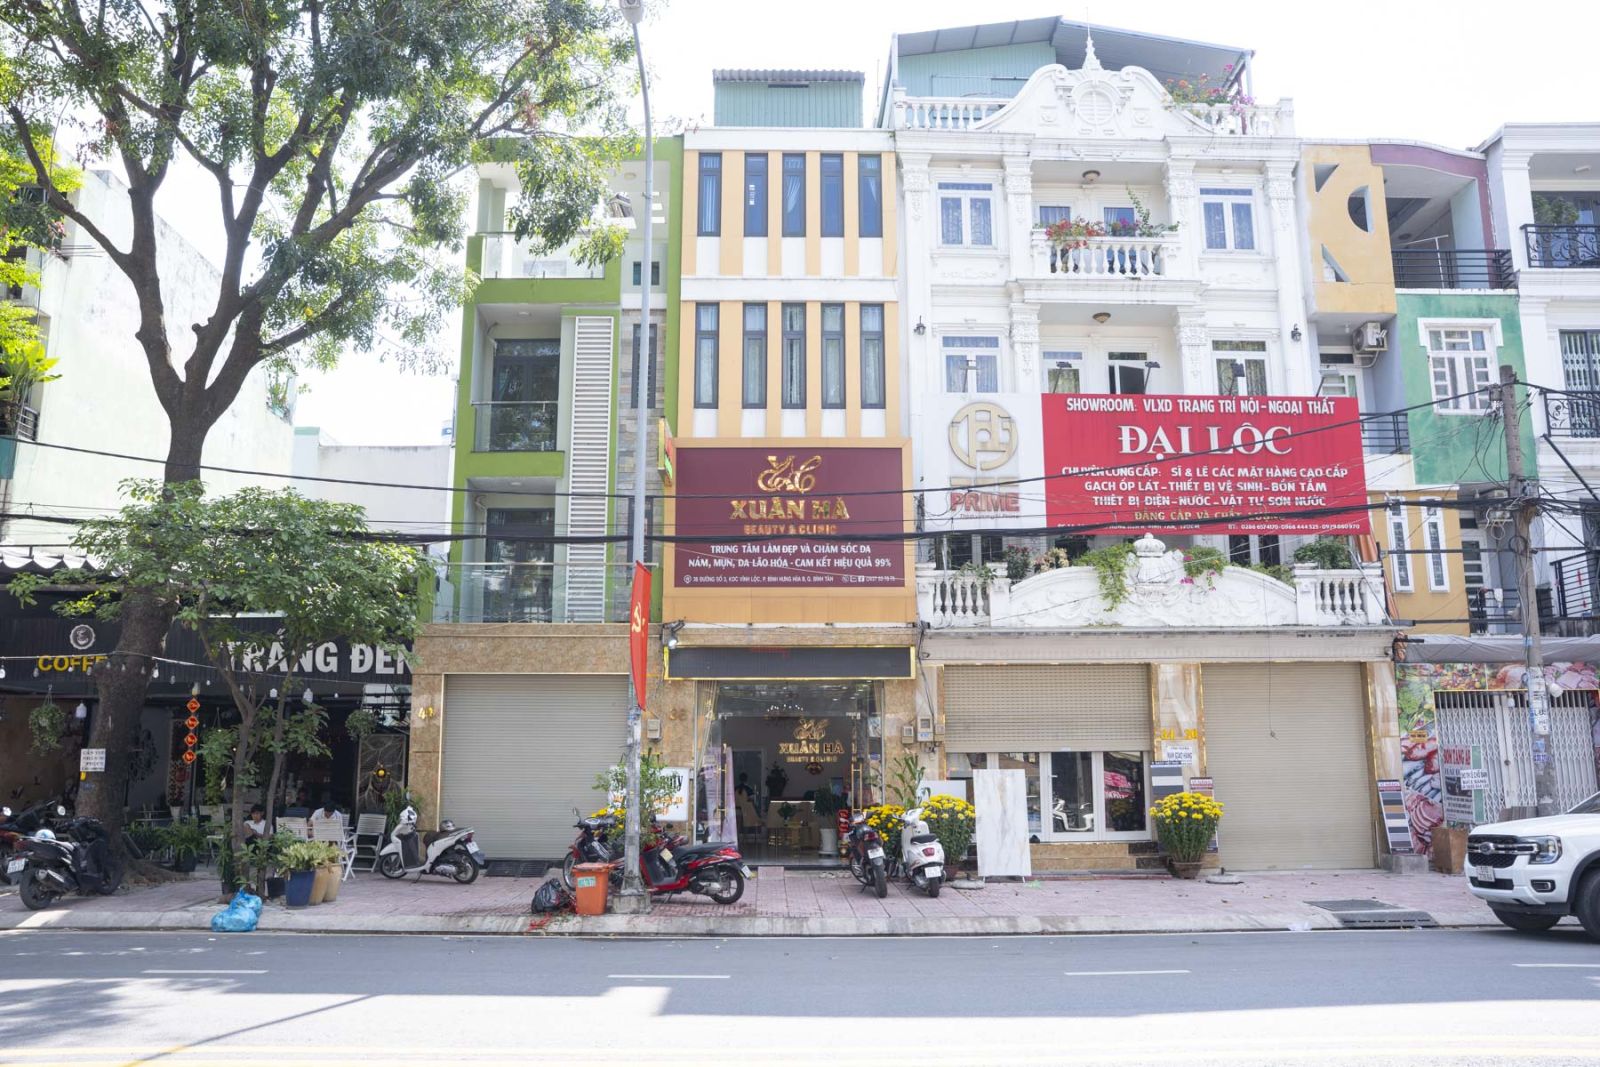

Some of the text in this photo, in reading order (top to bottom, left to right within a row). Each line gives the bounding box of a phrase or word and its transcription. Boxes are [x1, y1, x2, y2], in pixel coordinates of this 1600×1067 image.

[1066, 398, 1138, 412] SHOWROOM:
[1143, 399, 1173, 413] VLXD
[1177, 399, 1215, 413] TRANG
[1219, 397, 1236, 413] TRÍ
[1240, 397, 1260, 415] NỘI
[1268, 400, 1303, 416] NGOẠI
[1306, 397, 1335, 415] THẤT
[1117, 425, 1194, 460] ĐẠI
[1184, 467, 1193, 477] &
[1211, 465, 1235, 477] CÁC
[1237, 466, 1263, 479] MẶT
[1265, 465, 1297, 478] HÀNG
[1300, 468, 1323, 478] CAO
[1085, 481, 1116, 493] GẠCH
[1119, 477, 1135, 491] ỐP
[1138, 479, 1160, 491] LÁT
[1168, 478, 1200, 492] THIẾT
[1203, 481, 1215, 494] BỊ
[1236, 482, 1263, 492] SINH
[729, 496, 805, 520] XUÂN
[949, 493, 1020, 512] PRIME
[1128, 496, 1140, 508] BỊ
[1144, 493, 1170, 508] ĐIỆN
[1179, 494, 1212, 506] NƯỚC
[1219, 494, 1243, 508] VẬT
[1248, 496, 1265, 506] TƯ
[743, 525, 785, 535] BEAUTY
[799, 525, 838, 535] CLINIC
[711, 545, 739, 554] TRUNG
[742, 543, 760, 554] TÂM
[762, 543, 780, 554] LÀM
[782, 545, 798, 556] ĐẸP
[800, 543, 811, 554] VÀ
[813, 543, 839, 554] CHĂM
[860, 545, 871, 554] DA
[688, 556, 712, 569] NÁM,
[713, 558, 736, 570] MỤN,
[738, 558, 750, 567] DA
[752, 556, 769, 568] LÃO
[770, 556, 789, 568] HÓA
[794, 558, 814, 568] CAM
[815, 554, 832, 568] KẾT
[833, 556, 853, 569] HIỆU
[854, 555, 873, 569] QUẢ
[874, 558, 892, 568] 99%
